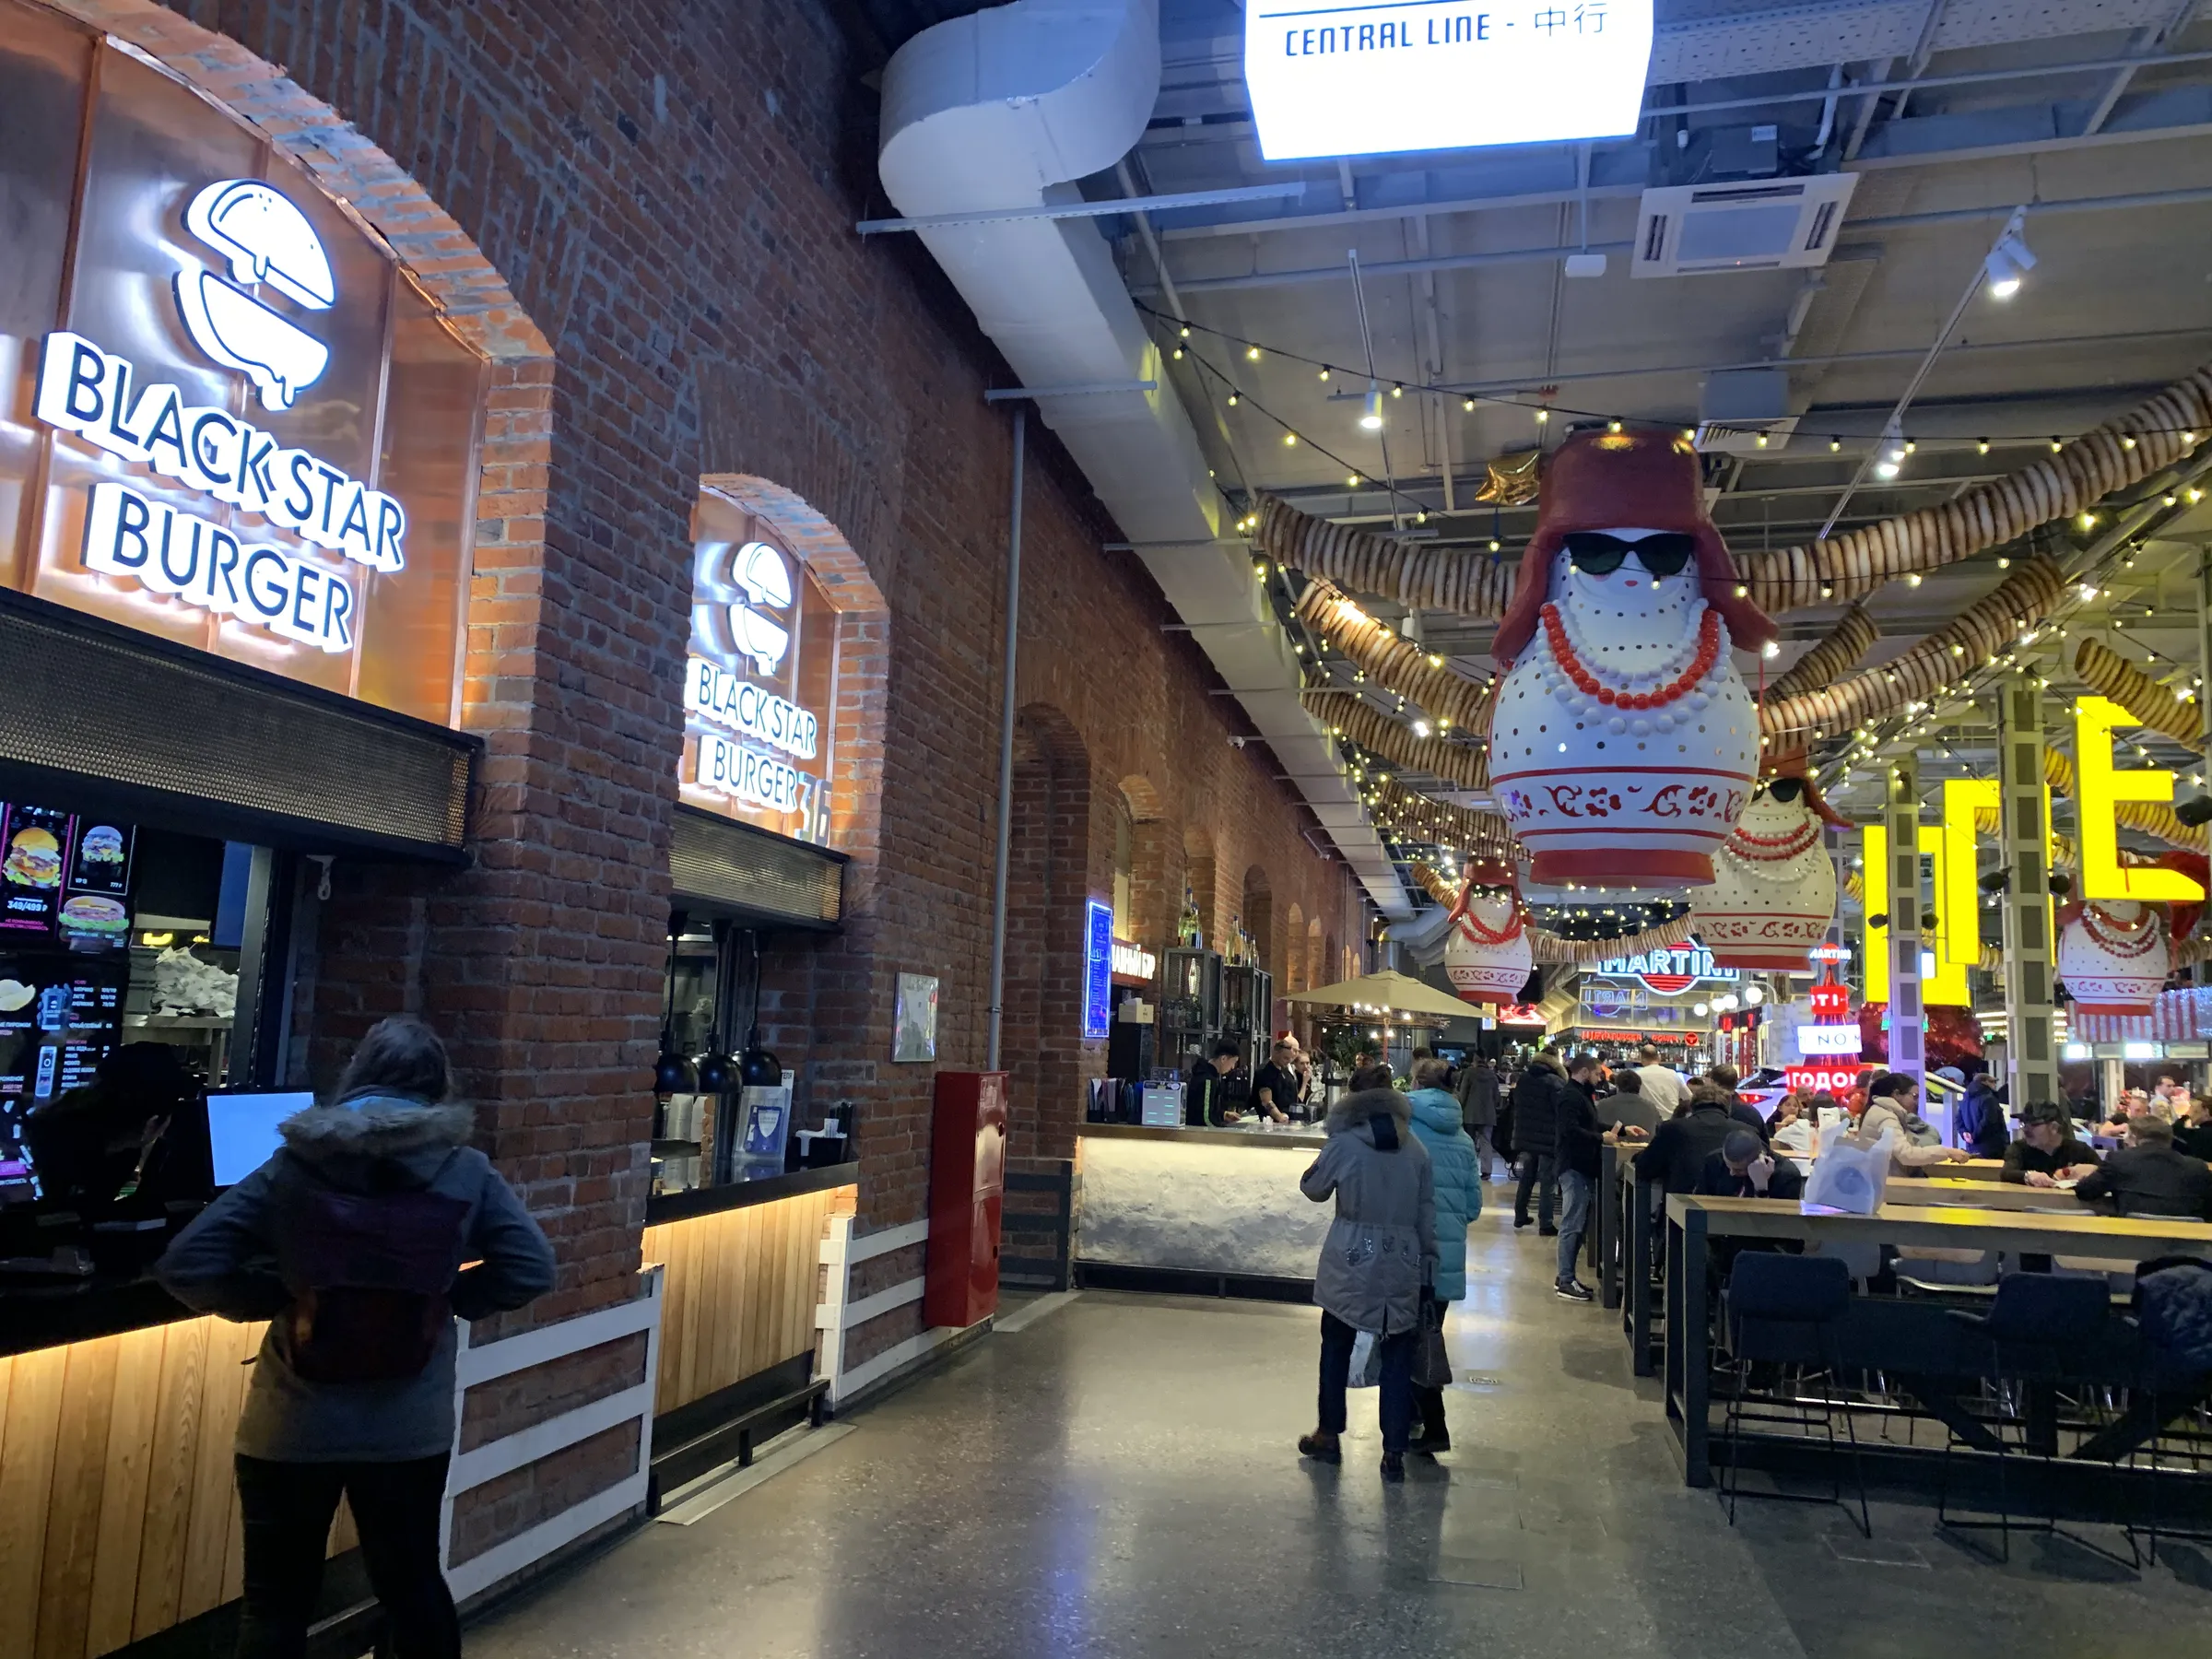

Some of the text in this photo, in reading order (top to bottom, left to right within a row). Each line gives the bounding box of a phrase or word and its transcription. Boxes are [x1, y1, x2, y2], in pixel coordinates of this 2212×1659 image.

[1285, 21, 1414, 56] CENTRAL
[1427, 13, 1490, 46] LINE
[1534, 2, 1608, 38] 中行
[65, 340, 404, 565] BLACK STAR
[112, 489, 351, 645] BURGER
[698, 664, 817, 755] BLACK STAR
[713, 739, 797, 808] BURGER
